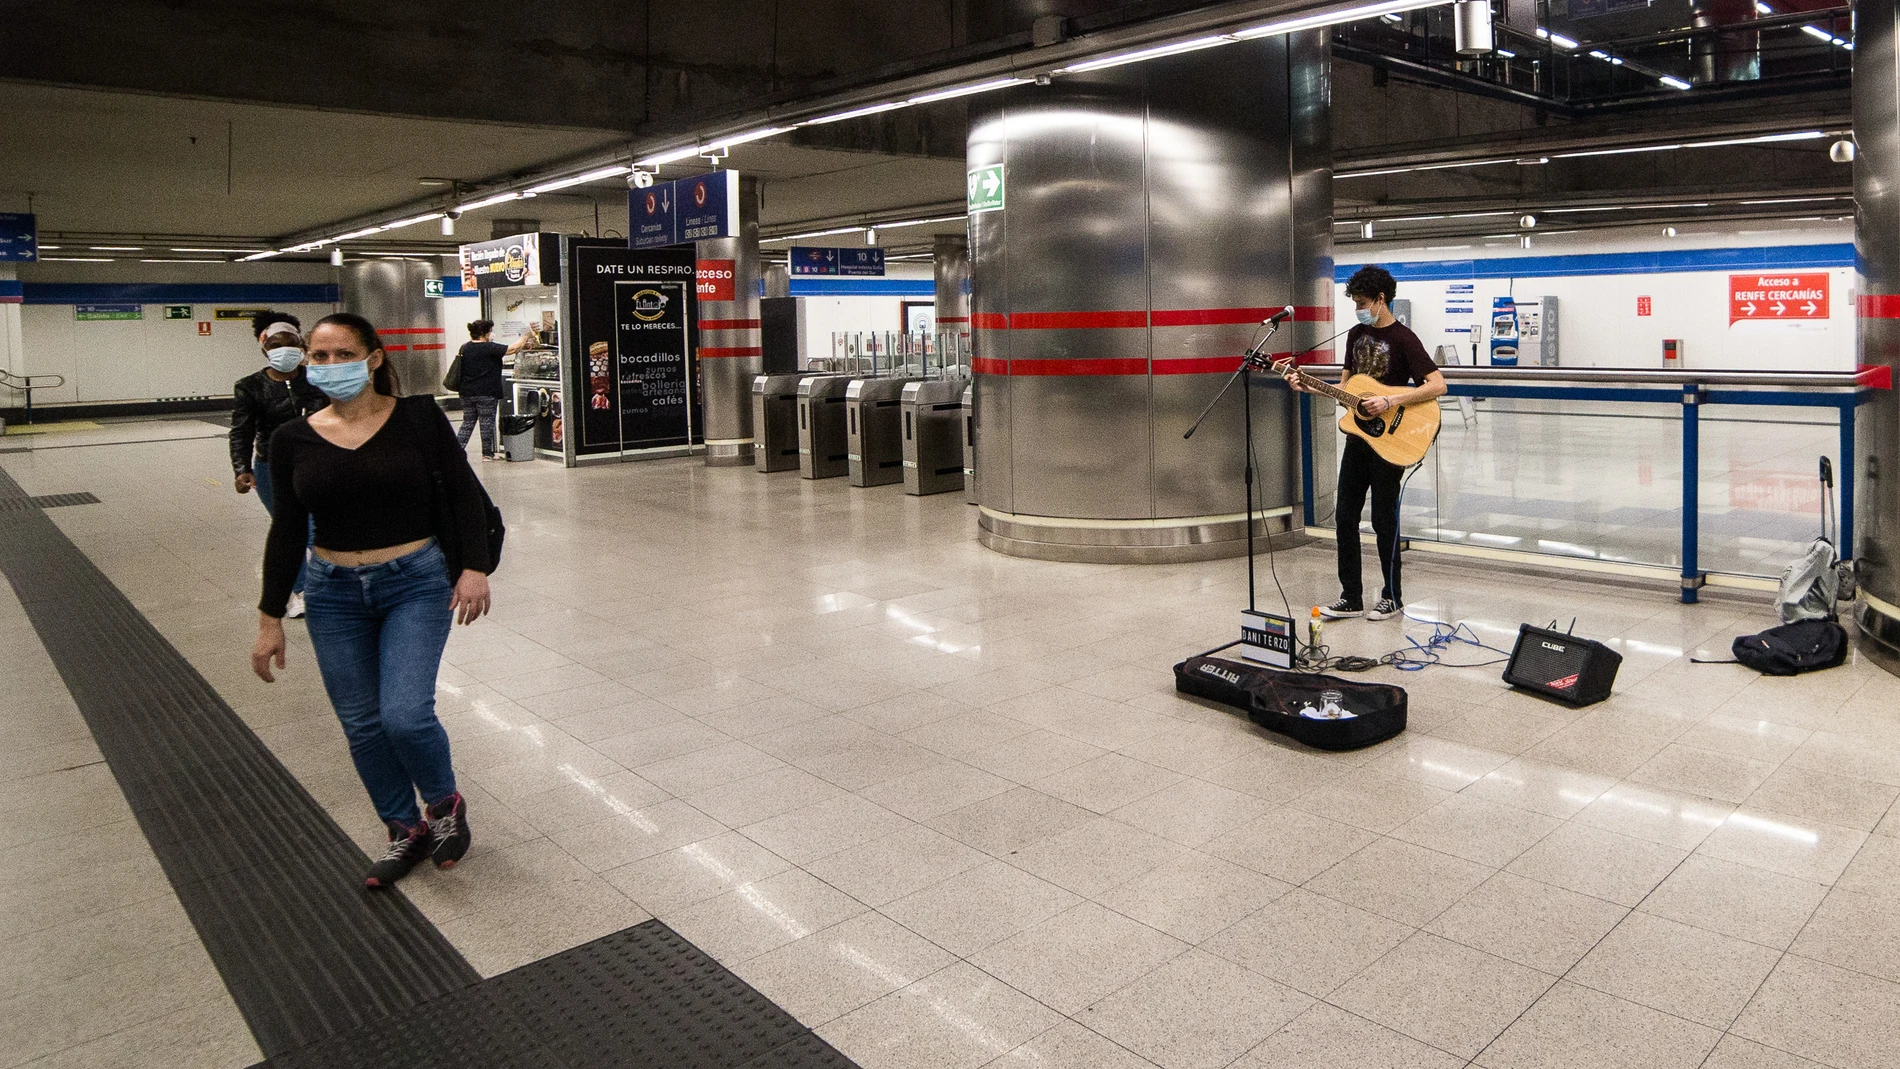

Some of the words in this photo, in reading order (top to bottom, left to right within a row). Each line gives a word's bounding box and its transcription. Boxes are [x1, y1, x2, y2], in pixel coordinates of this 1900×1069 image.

[857, 253, 867, 261] 10
[596, 264, 624, 274] DATE
[627, 264, 644, 274] UN
[647, 265, 695, 275] RESPIRO.
[1757, 277, 1790, 287] Acceso
[1792, 278, 1799, 286] a
[1735, 291, 1766, 301] RENFE
[1767, 288, 1823, 300] CERCANÍAS
[620, 352, 680, 364] bocadillos
[646, 366, 677, 374] zumos
[621, 372, 666, 380] refrescos
[652, 395, 683, 406] cafés
[1242, 629, 1261, 641] DANI
[1263, 634, 1288, 649] TERZO
[1541, 641, 1566, 653] CUBE
[1200, 663, 1240, 684] RITTER
